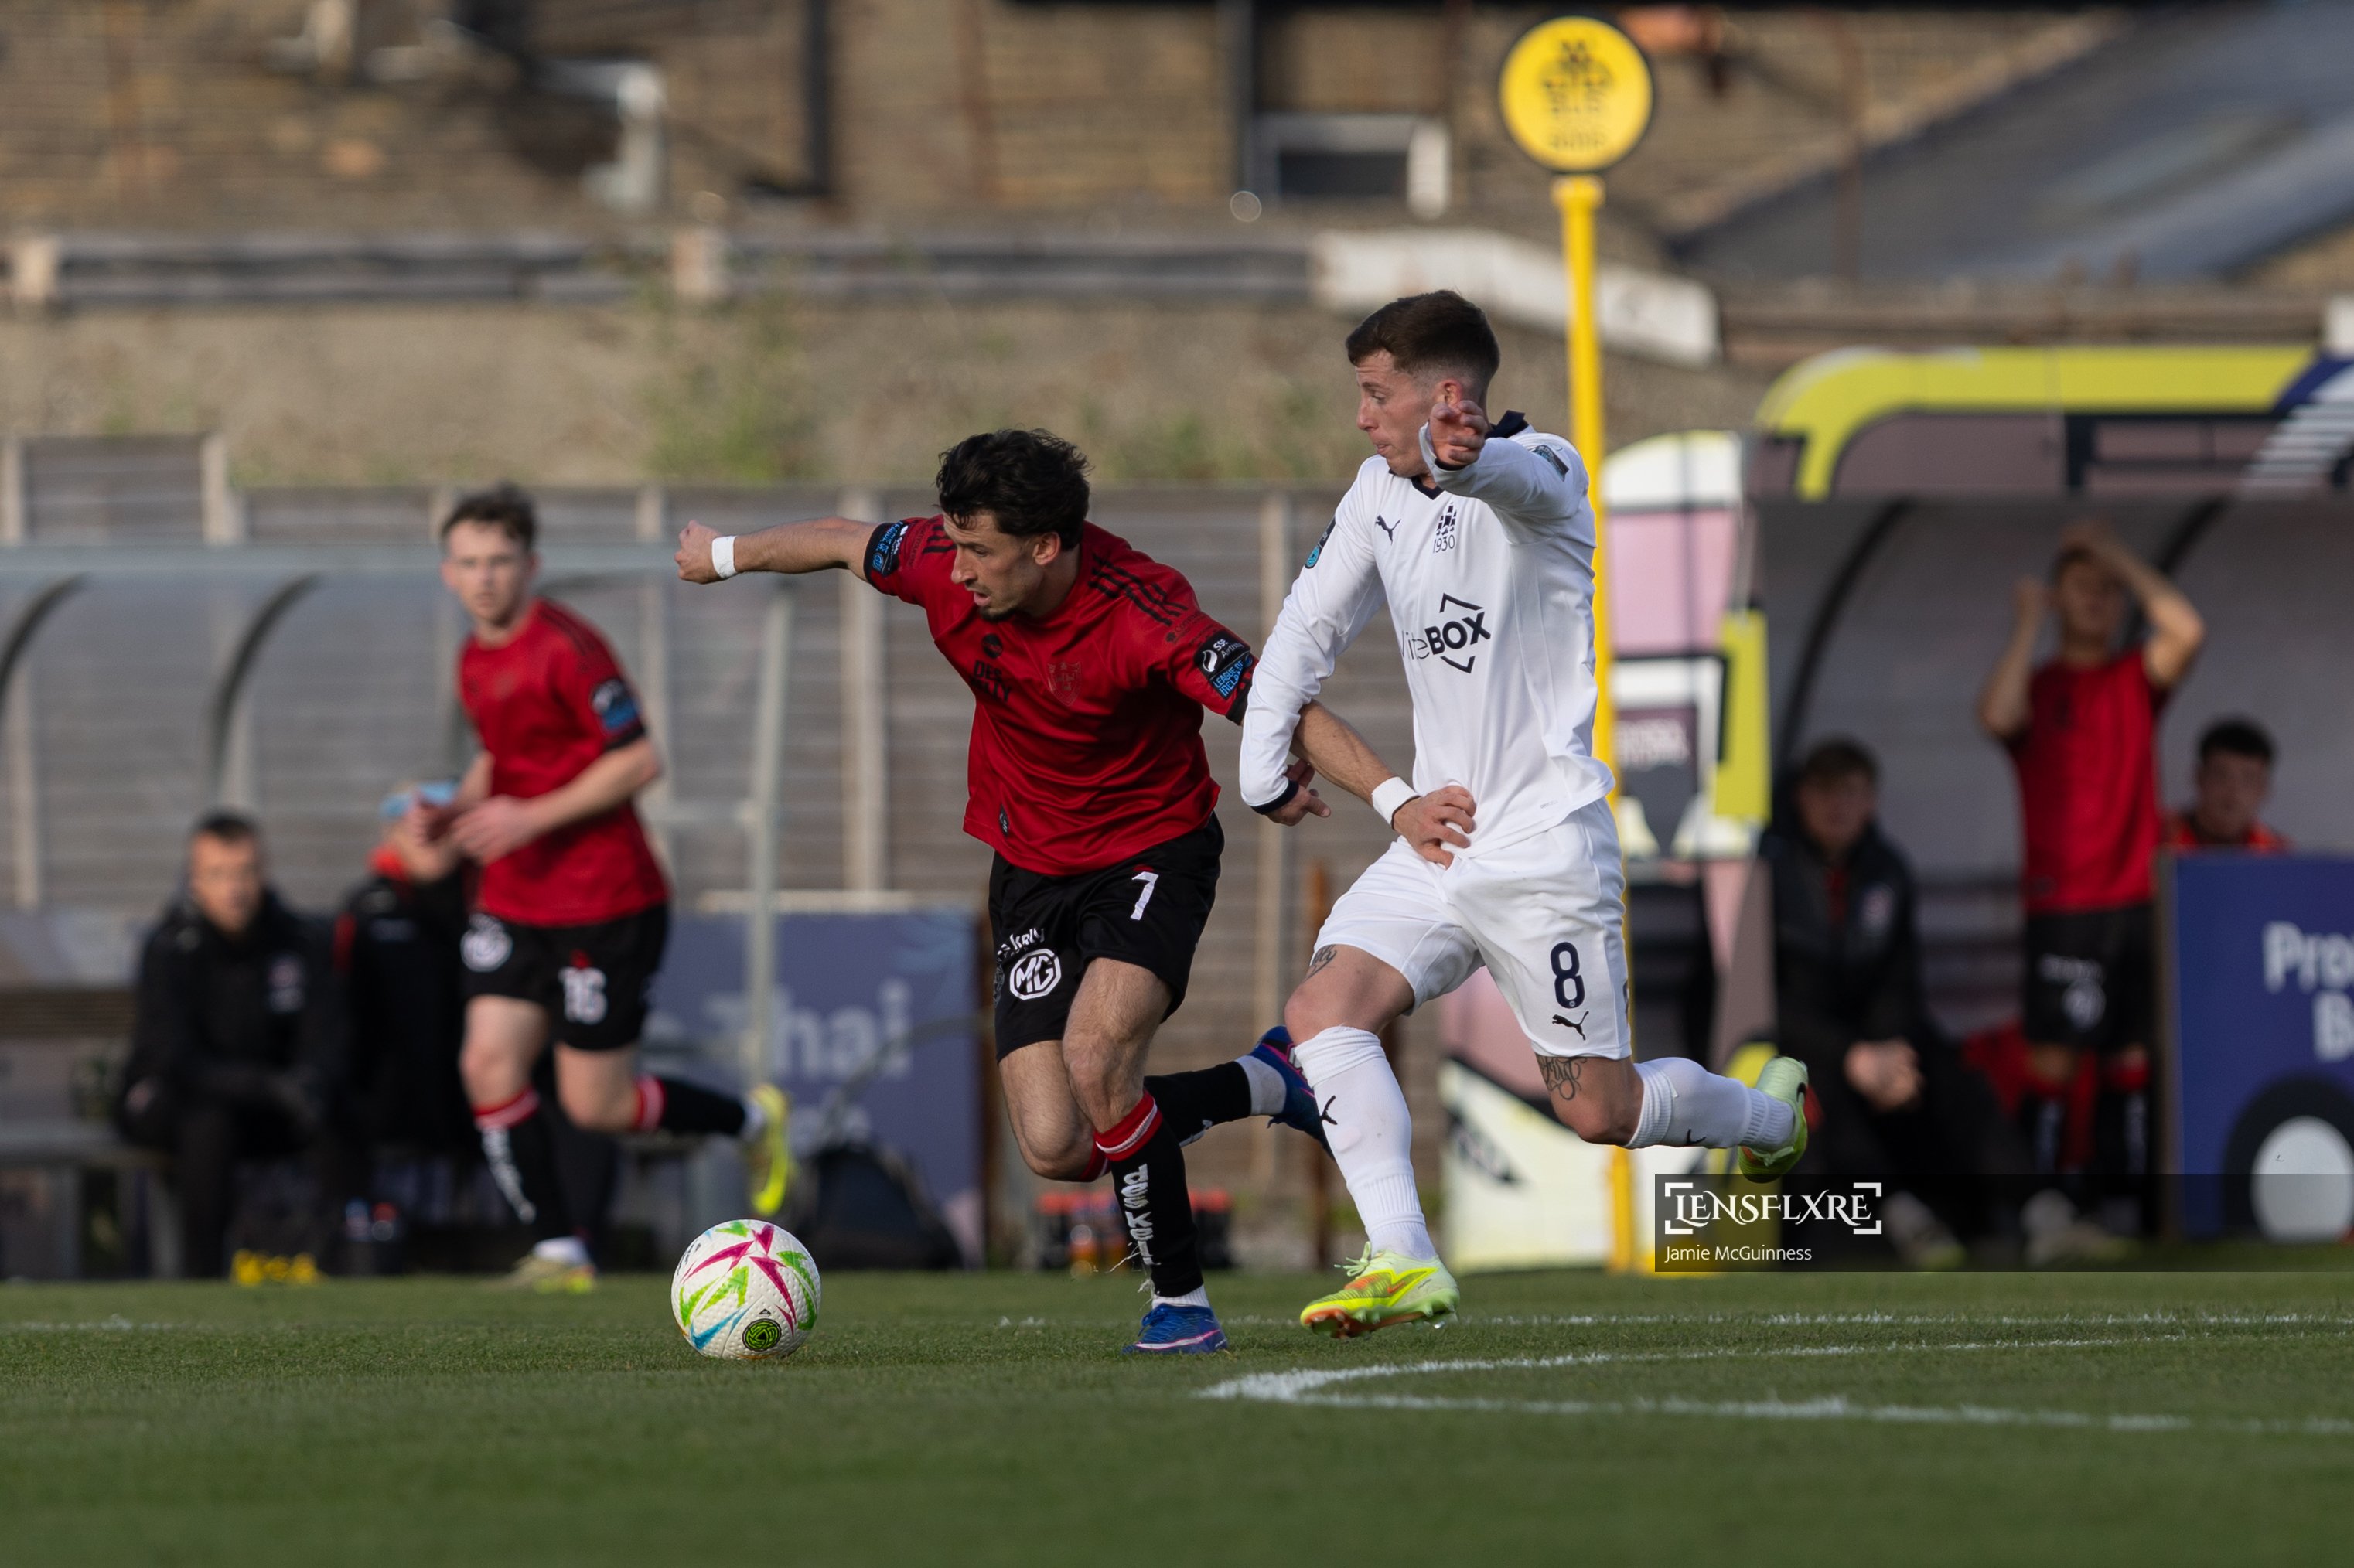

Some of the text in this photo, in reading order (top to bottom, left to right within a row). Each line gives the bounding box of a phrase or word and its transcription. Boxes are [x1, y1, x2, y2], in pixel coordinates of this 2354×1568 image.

[1433, 534, 1455, 553] 1930
[1213, 666, 1236, 688] LEAGUE
[1131, 871, 1158, 920] 7
[1014, 953, 1056, 995] MG
[1550, 941, 1585, 1009] 8
